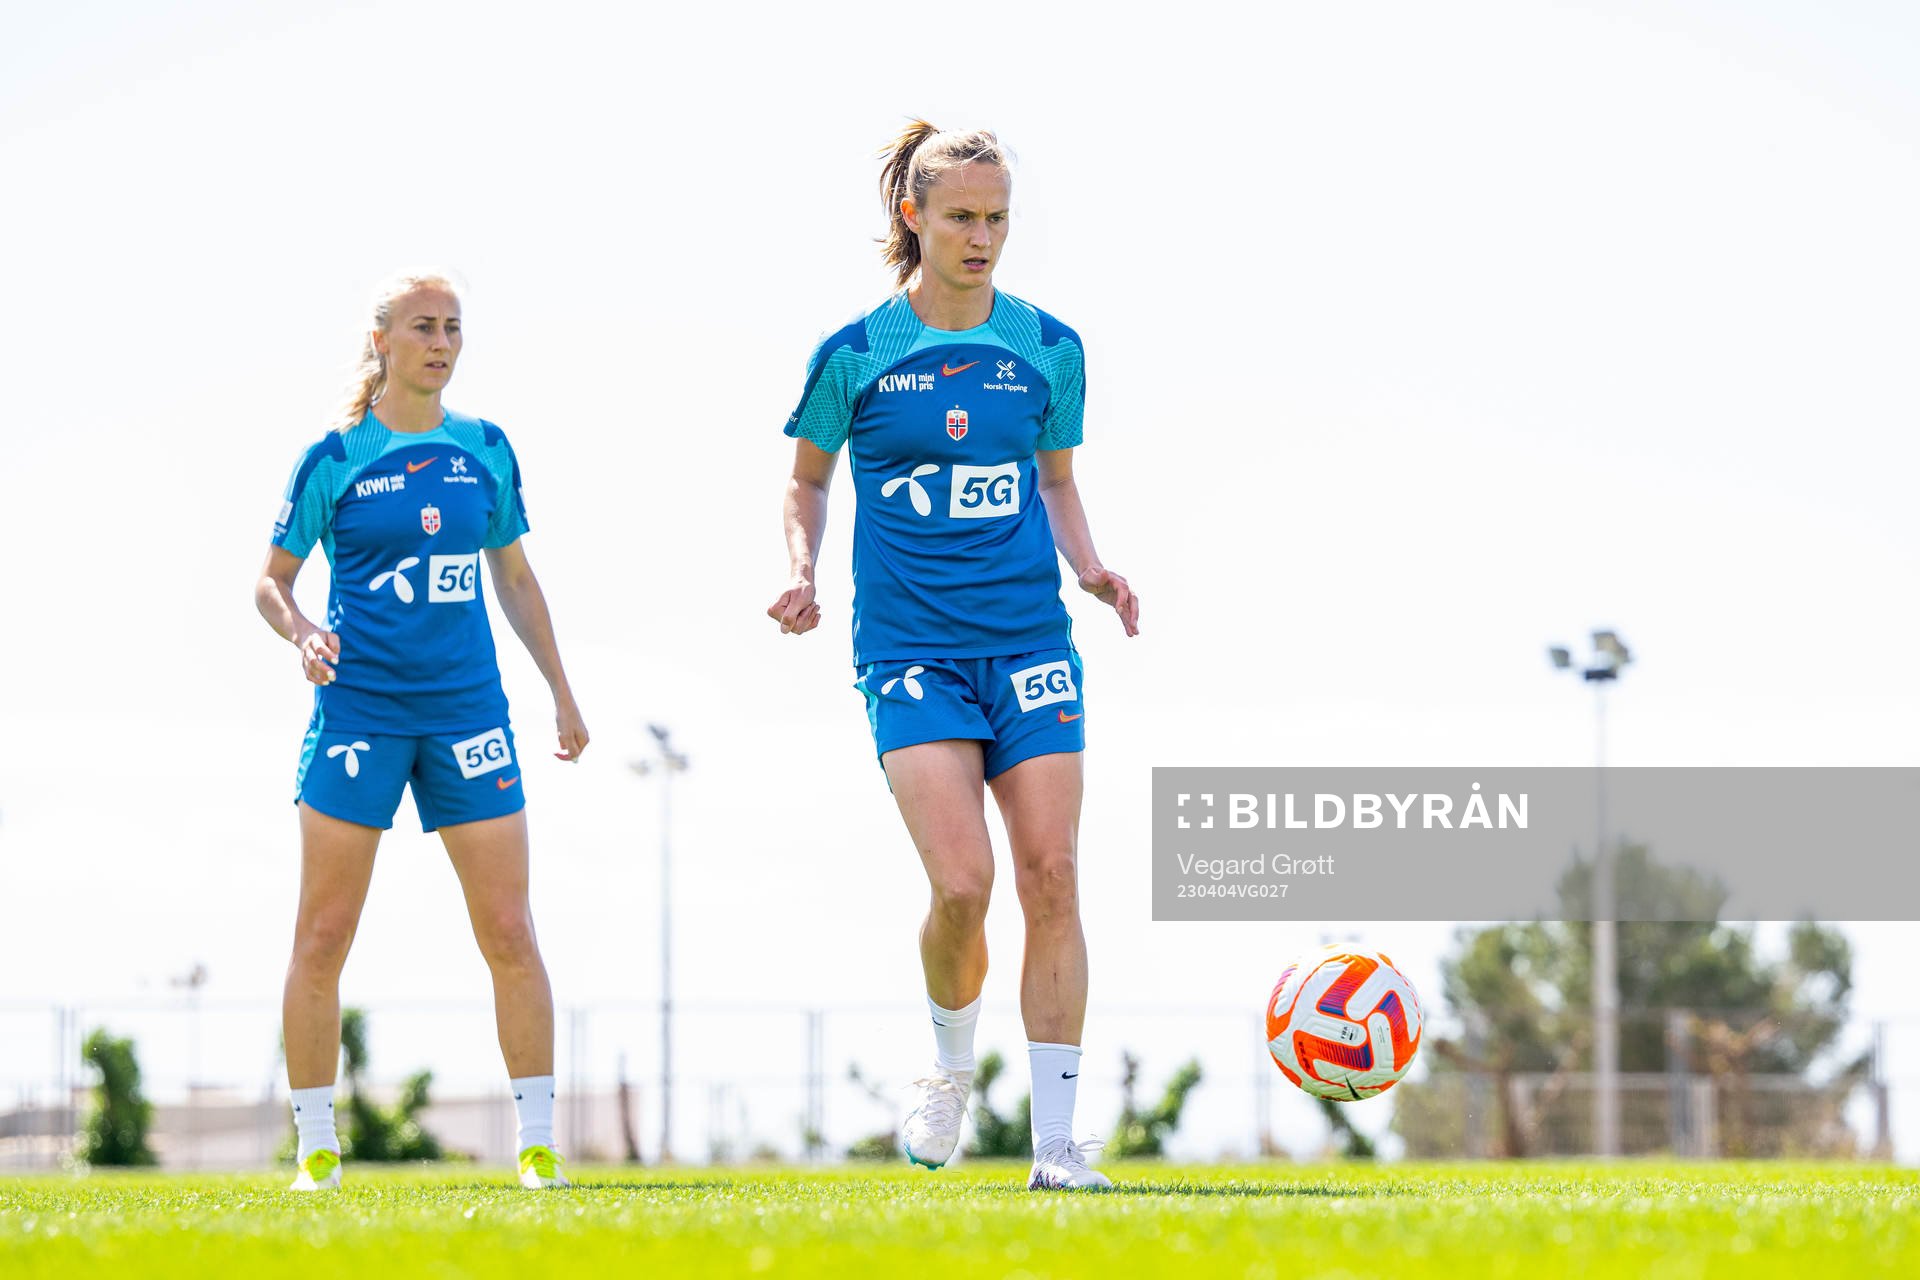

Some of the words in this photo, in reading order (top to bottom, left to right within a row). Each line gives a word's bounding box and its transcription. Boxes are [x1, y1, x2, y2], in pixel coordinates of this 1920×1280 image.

[878, 373, 917, 392] KIWI
[918, 372, 935, 382] mini
[918, 381, 934, 392] pris
[1004, 384, 1028, 393] Tipping
[355, 476, 391, 498] KIWI
[958, 474, 1015, 509] 5G
[437, 564, 474, 593] 5G
[1024, 669, 1069, 701] 5G
[465, 738, 505, 768] 5G
